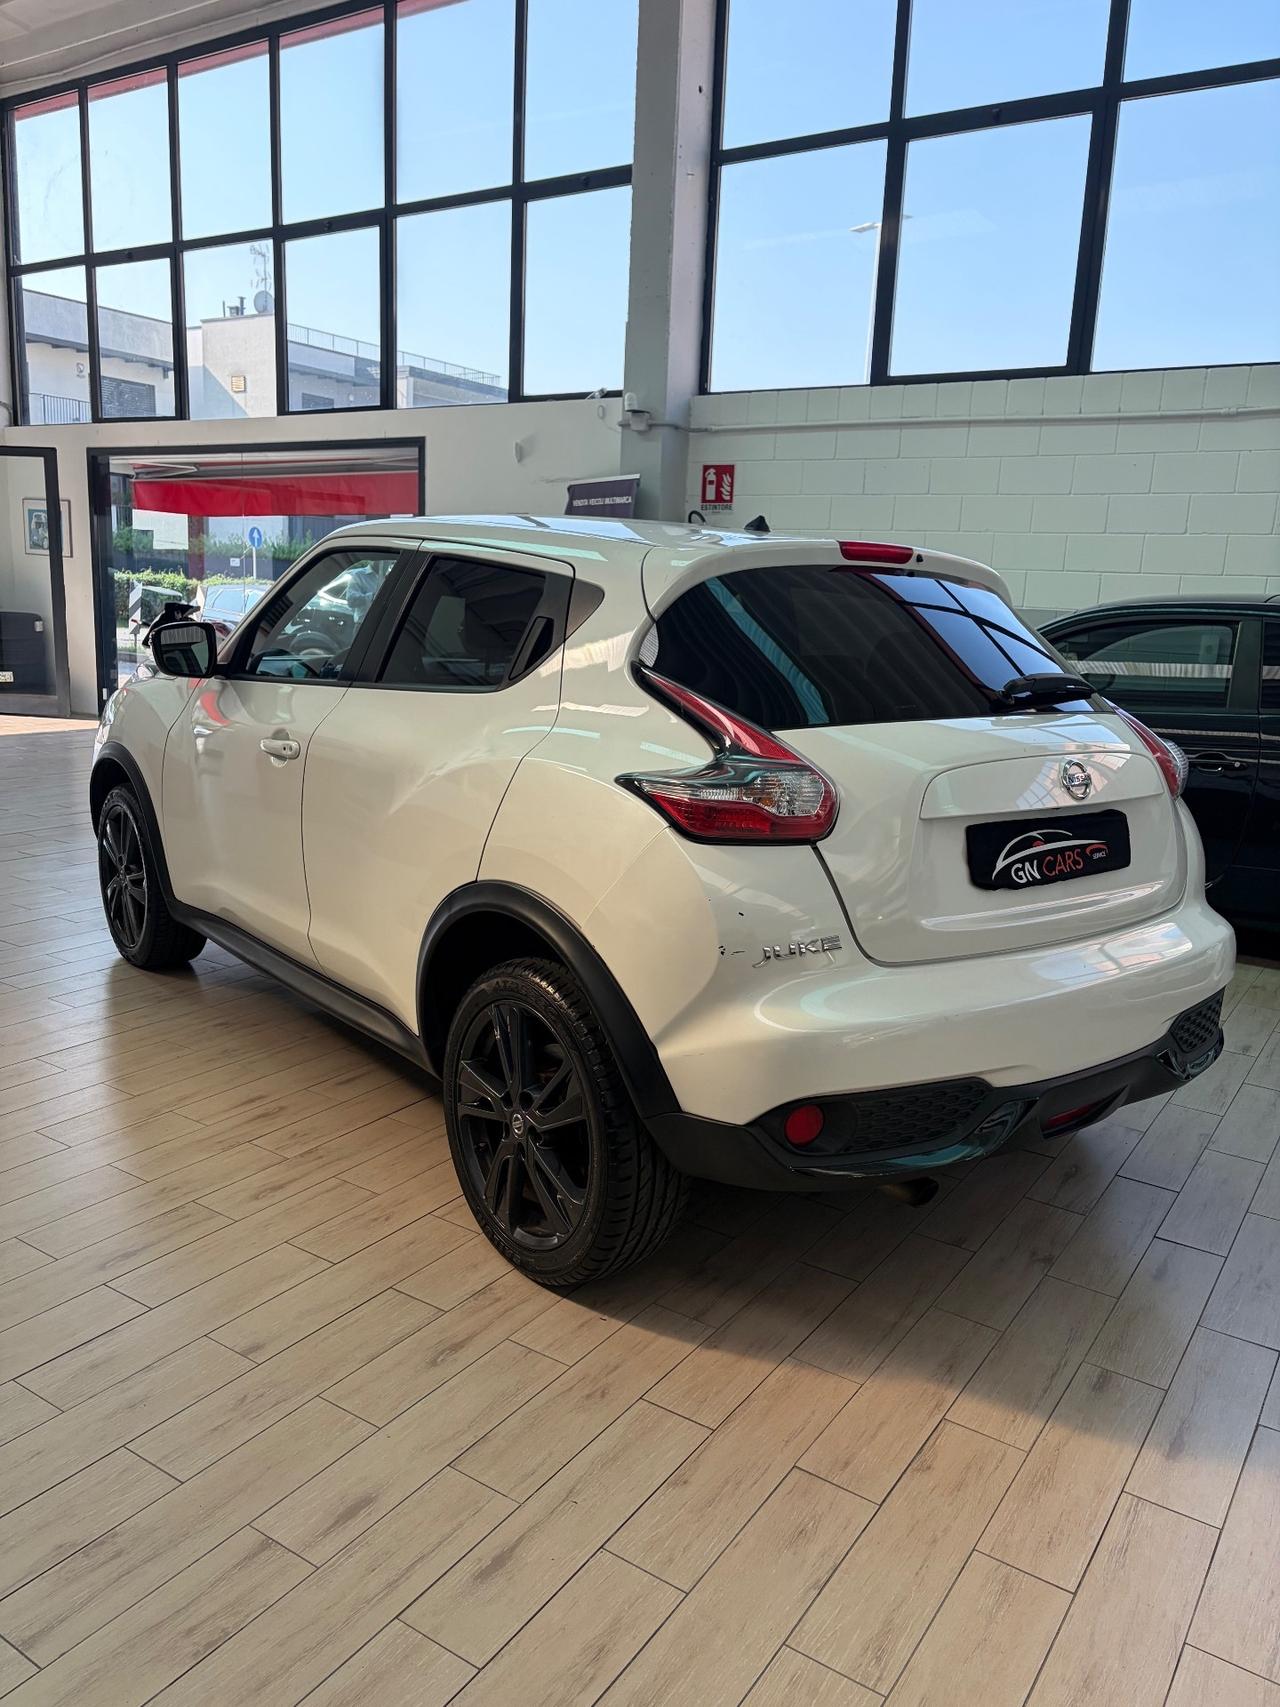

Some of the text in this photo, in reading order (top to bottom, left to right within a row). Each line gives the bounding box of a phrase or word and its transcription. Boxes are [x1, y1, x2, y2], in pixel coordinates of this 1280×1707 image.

[1010, 849, 1084, 884] GN CARS
[752, 934, 842, 968] JUKE
